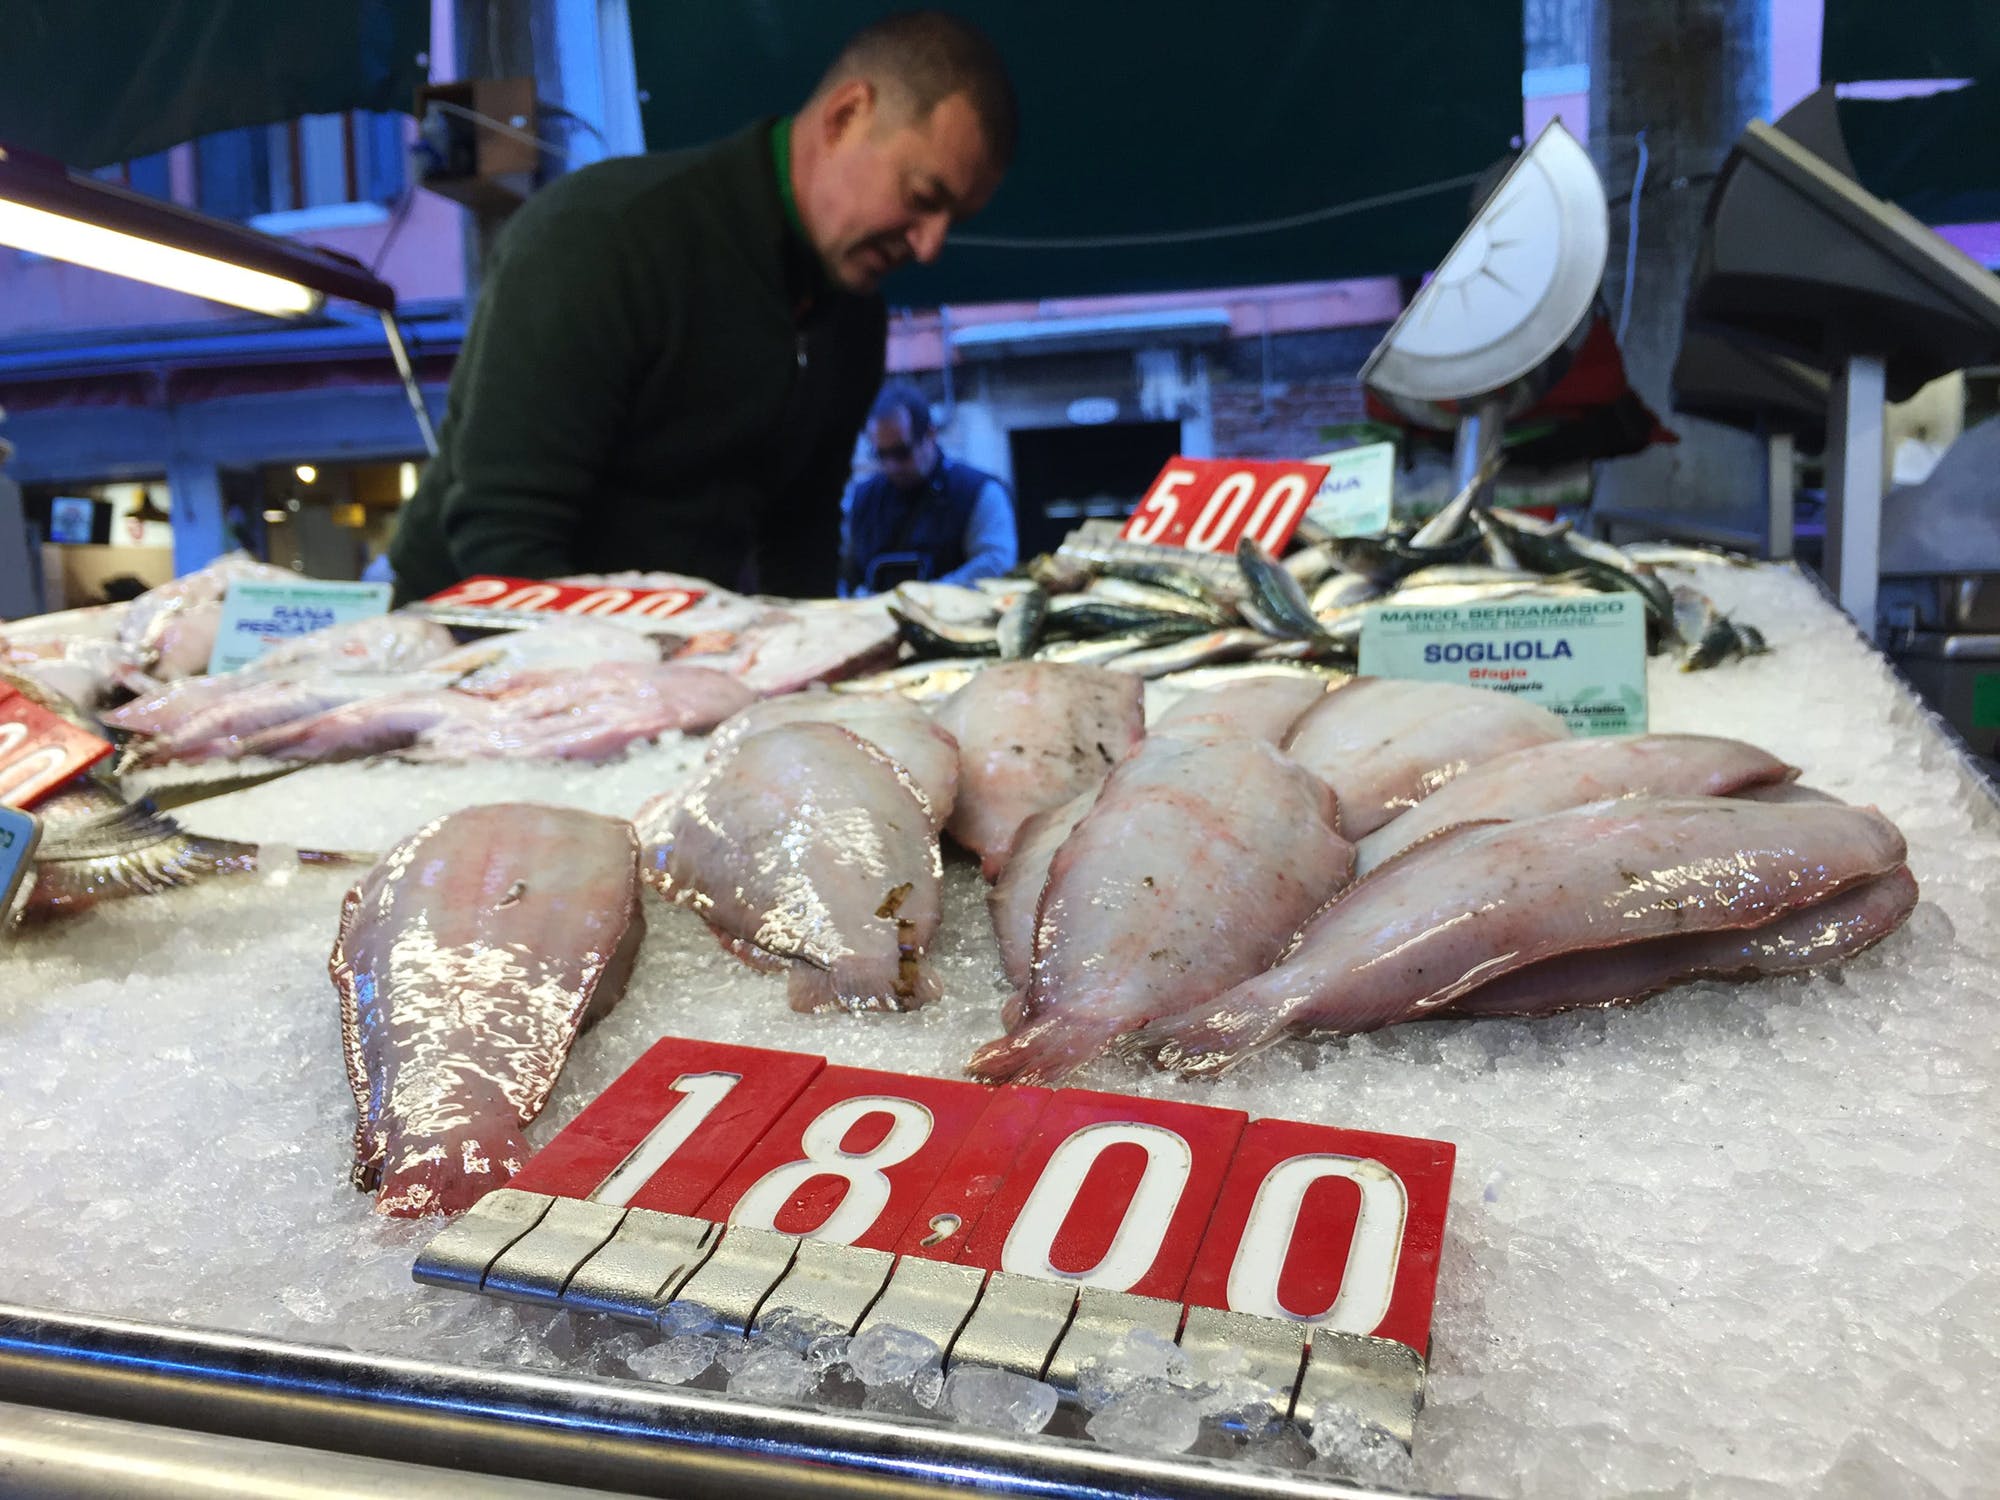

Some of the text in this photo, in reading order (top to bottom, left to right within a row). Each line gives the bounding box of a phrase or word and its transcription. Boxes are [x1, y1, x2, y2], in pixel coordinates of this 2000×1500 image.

[273, 605, 335, 620] RANA
[1380, 601, 1624, 623] MARCO BERGAMASCO
[1405, 615, 1596, 633] SOLO PESCE NOSTRANO
[1424, 638, 1574, 664] SOGLIOLA
[1492, 681, 1544, 693] vulgaris
